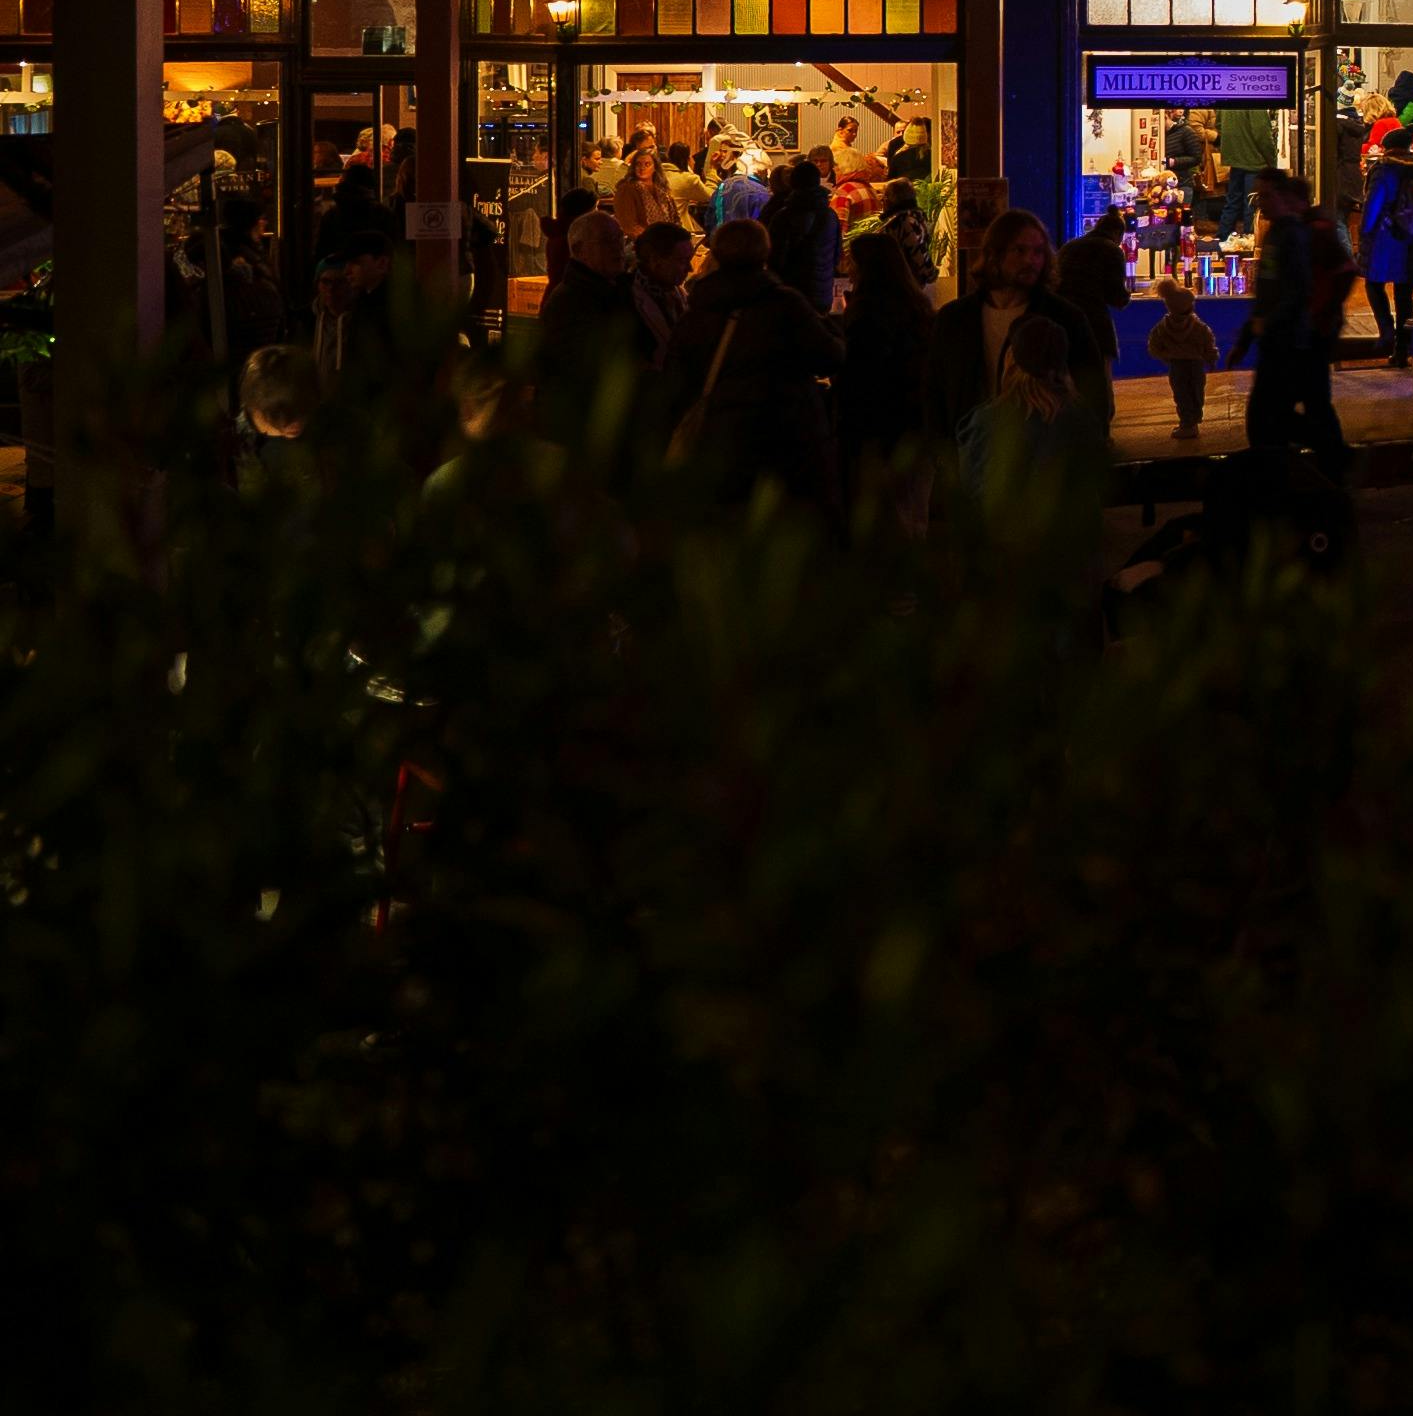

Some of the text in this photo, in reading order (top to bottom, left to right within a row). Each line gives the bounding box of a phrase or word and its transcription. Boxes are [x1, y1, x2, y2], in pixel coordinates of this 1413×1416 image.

[1103, 73, 1223, 92] MILLTHORPE
[1229, 73, 1279, 83] Sweets
[1225, 82, 1282, 92] & Treats
